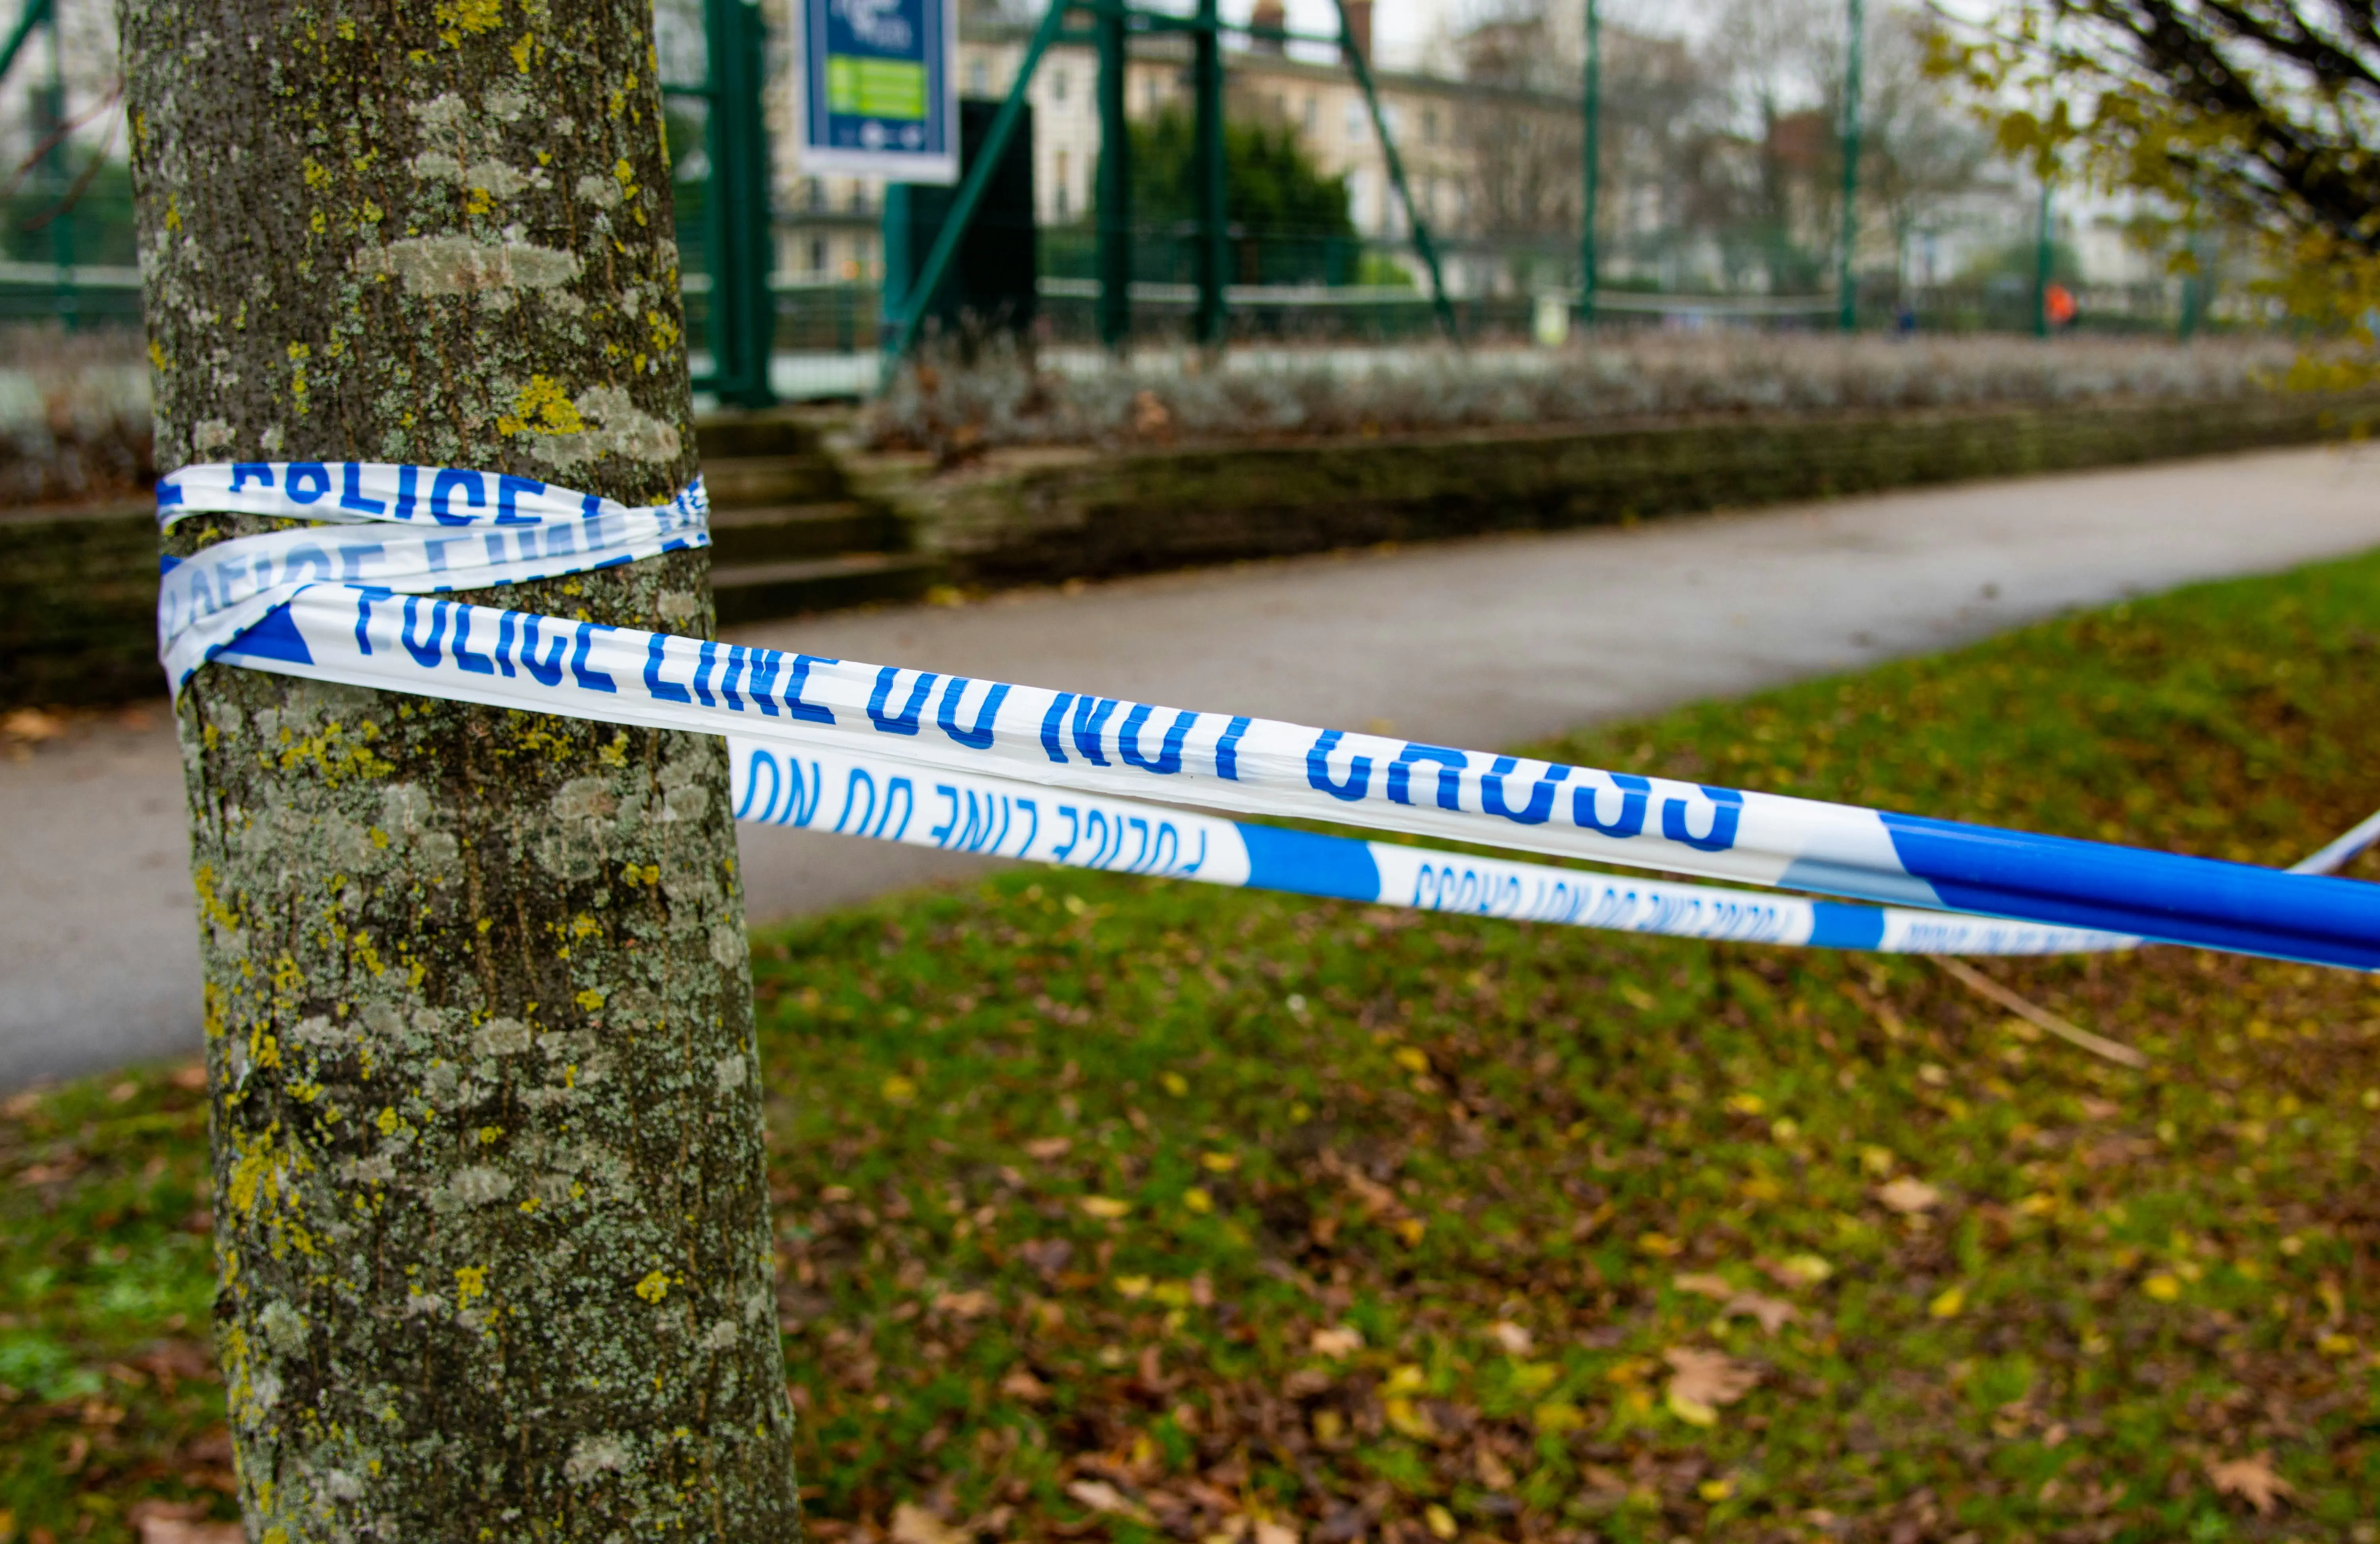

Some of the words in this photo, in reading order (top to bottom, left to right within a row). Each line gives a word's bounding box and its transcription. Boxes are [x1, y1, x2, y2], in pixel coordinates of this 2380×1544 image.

[354, 588, 618, 693] POLICE
[643, 632, 840, 725] LINE
[866, 666, 1013, 750] DO
[735, 750, 821, 829] NO
